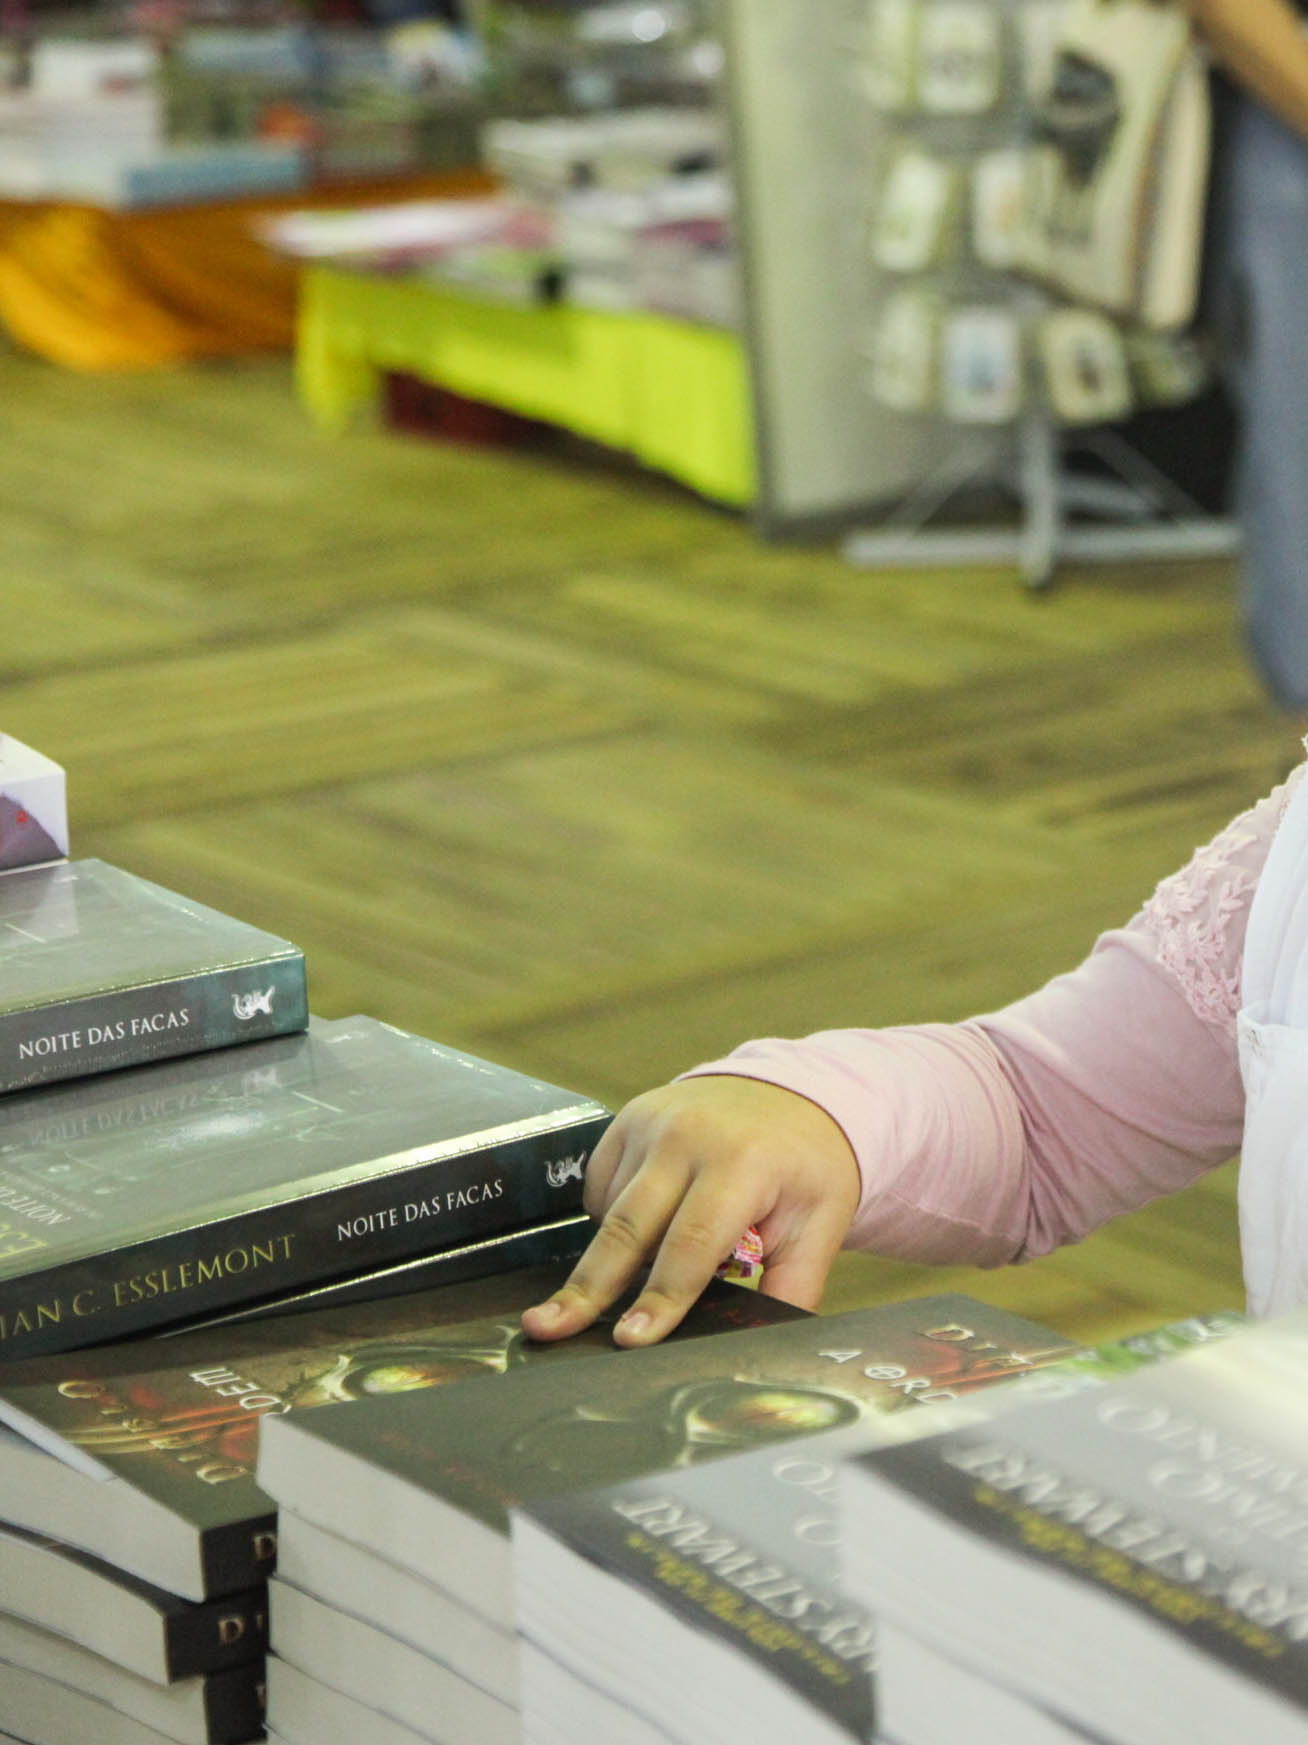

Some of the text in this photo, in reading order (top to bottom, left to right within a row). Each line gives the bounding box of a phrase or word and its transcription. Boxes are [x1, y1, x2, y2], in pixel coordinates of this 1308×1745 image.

[18, 1008, 190, 1060] NOITE DAS FACAS
[337, 1179, 503, 1241] NOITE DAS FACAS
[0, 1233, 296, 1340] IAN C. ESSLEMONT
[864, 1362, 957, 1403] ORD
[942, 1442, 1234, 1592] STEWART
[611, 1500, 838, 1620] STEWART
